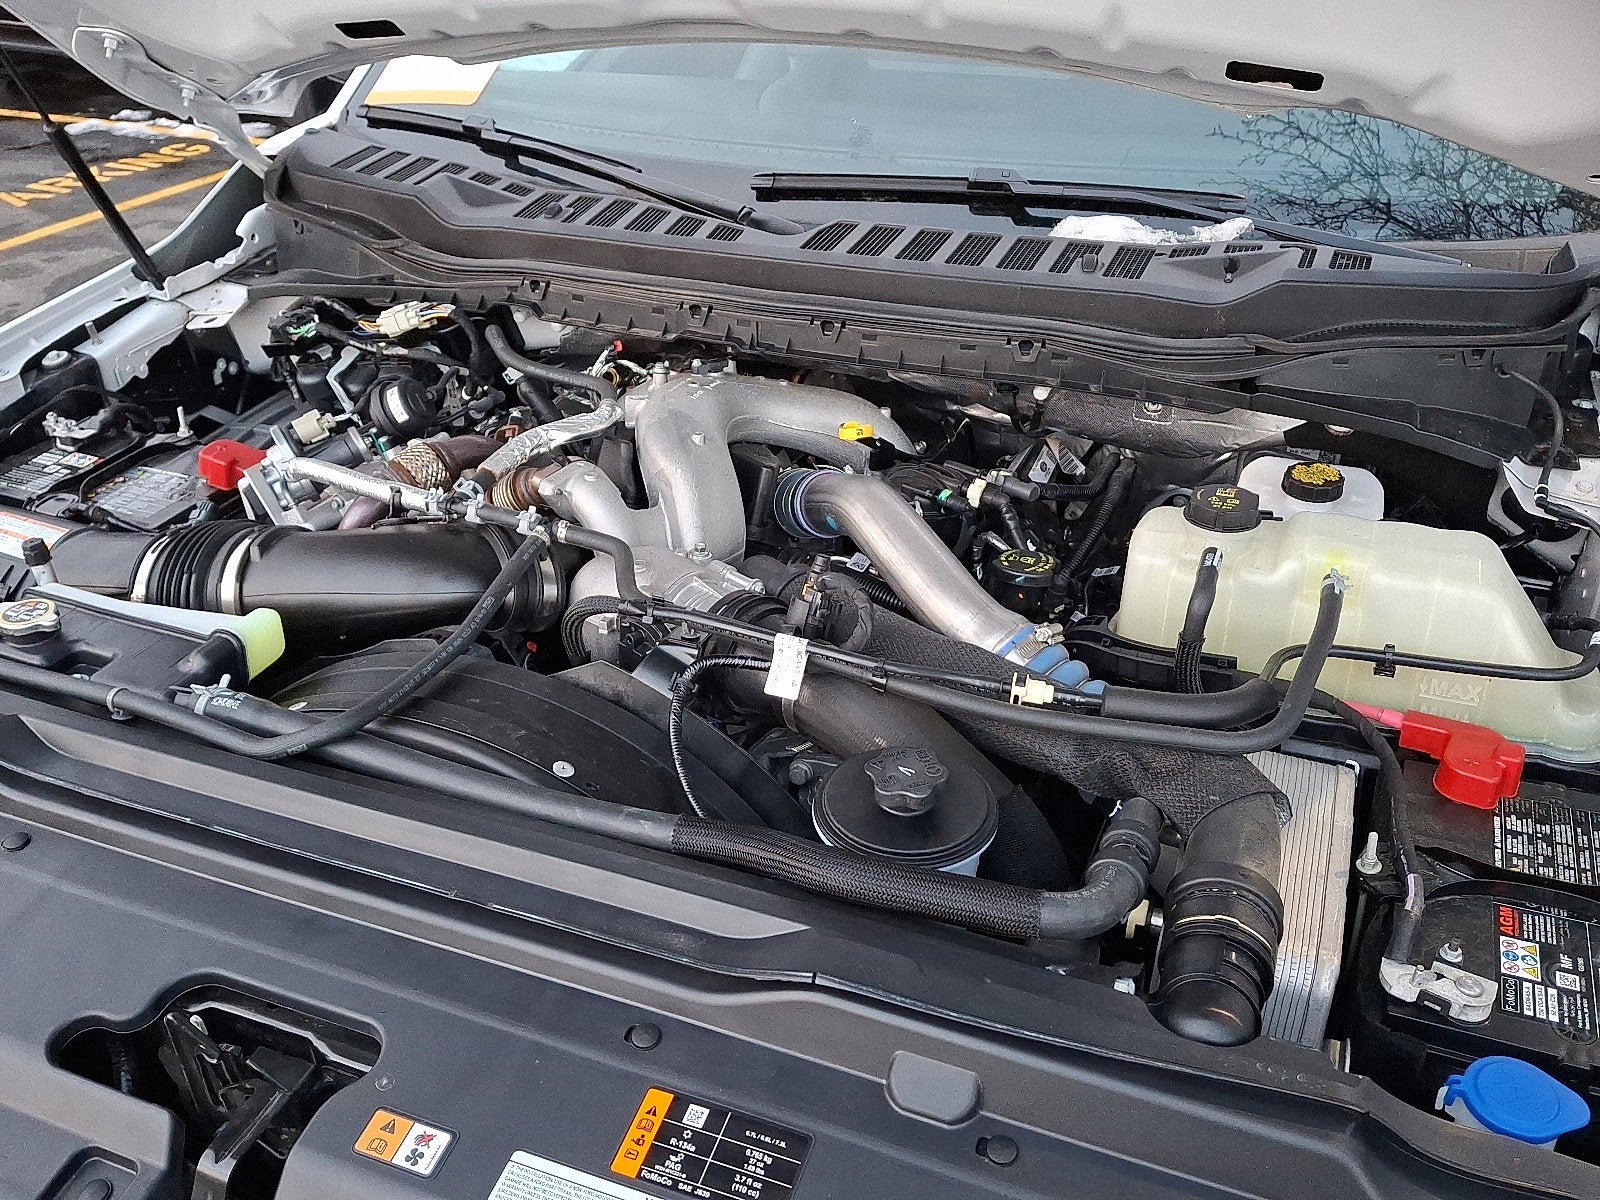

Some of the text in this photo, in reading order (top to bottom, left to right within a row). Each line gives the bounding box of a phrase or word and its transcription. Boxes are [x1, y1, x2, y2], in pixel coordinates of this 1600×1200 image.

[1429, 678, 1483, 702] MAX
[1500, 905, 1514, 936] AGM
[1560, 953, 1573, 969] MF
[1505, 979, 1515, 1011] FoMoCo
[669, 1137, 696, 1152] R-134a
[664, 1160, 682, 1171] PAG
[763, 1154, 773, 1165] kg
[640, 1169, 673, 1186] FoMoCo
[677, 1182, 693, 1193] SAE
[734, 1174, 747, 1183] 3.7
[752, 1182, 763, 1190] oz
[731, 1182, 760, 1199] (110 cc)
